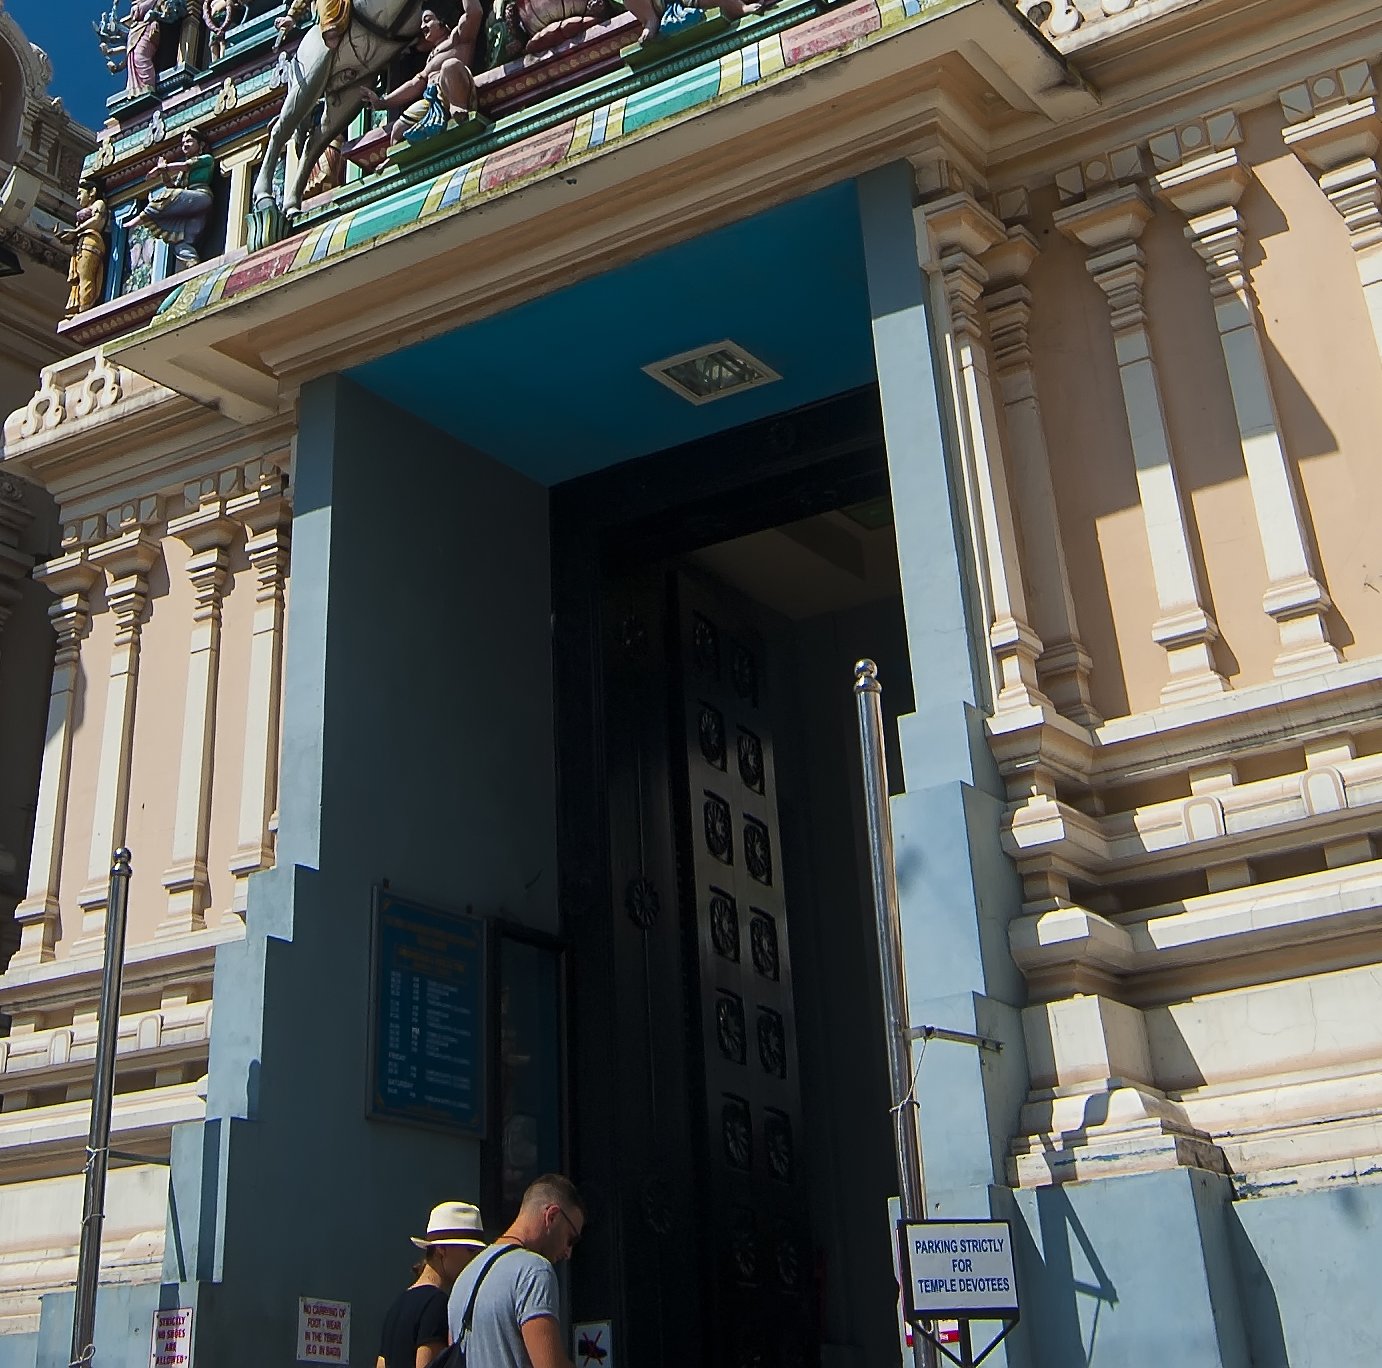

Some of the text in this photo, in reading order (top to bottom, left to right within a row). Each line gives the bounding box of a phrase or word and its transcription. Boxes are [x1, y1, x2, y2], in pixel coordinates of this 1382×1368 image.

[915, 1238, 1004, 1254] PARKING STRICTLY
[952, 1259, 973, 1272] FOR
[918, 1277, 1010, 1293] TEMPLE DEVOTEES
